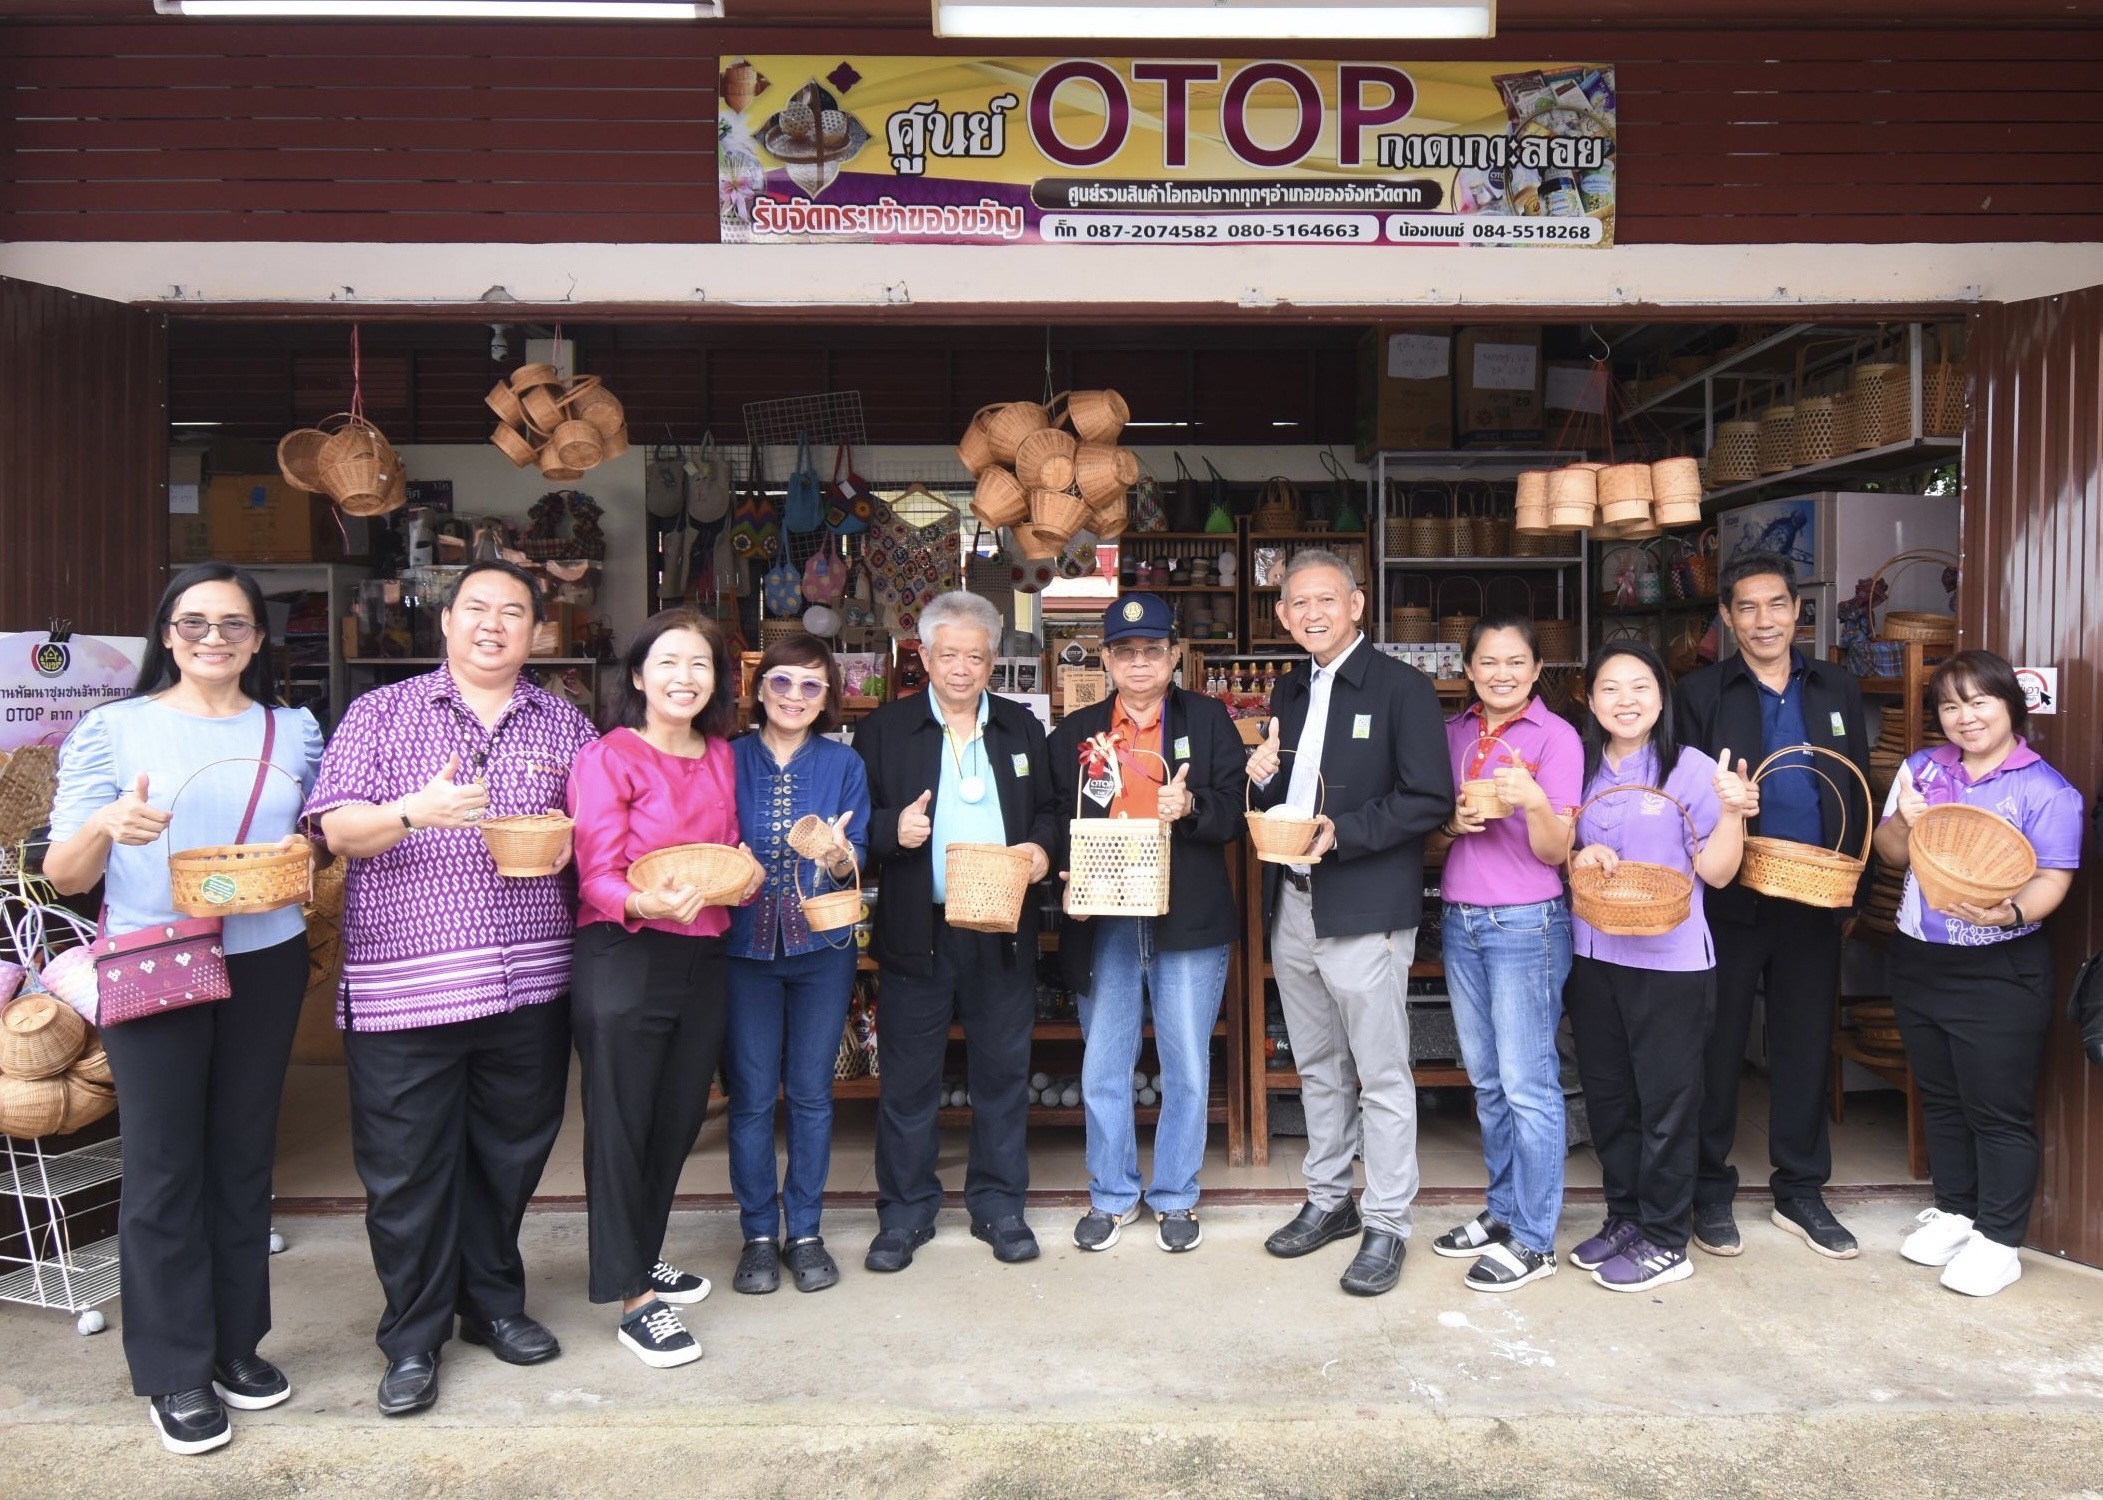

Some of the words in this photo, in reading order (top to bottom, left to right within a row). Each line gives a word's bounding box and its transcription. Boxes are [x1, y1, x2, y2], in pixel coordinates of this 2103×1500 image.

[887, 95, 1019, 174] ศูนย์
[1027, 58, 1418, 169] OTOP
[1378, 133, 1605, 170] กาดเกาะลอย
[752, 196, 1024, 237] รับจัดกระเช้าของขวัญ
[1086, 224, 1218, 239] 087-2074582
[1228, 224, 1360, 239] 080-5164663
[1399, 221, 1465, 238] น้องเบนซ์
[1473, 224, 1591, 240] 084-5518268
[6, 707, 45, 722] OTOP
[50, 710, 73, 721] ตาก
